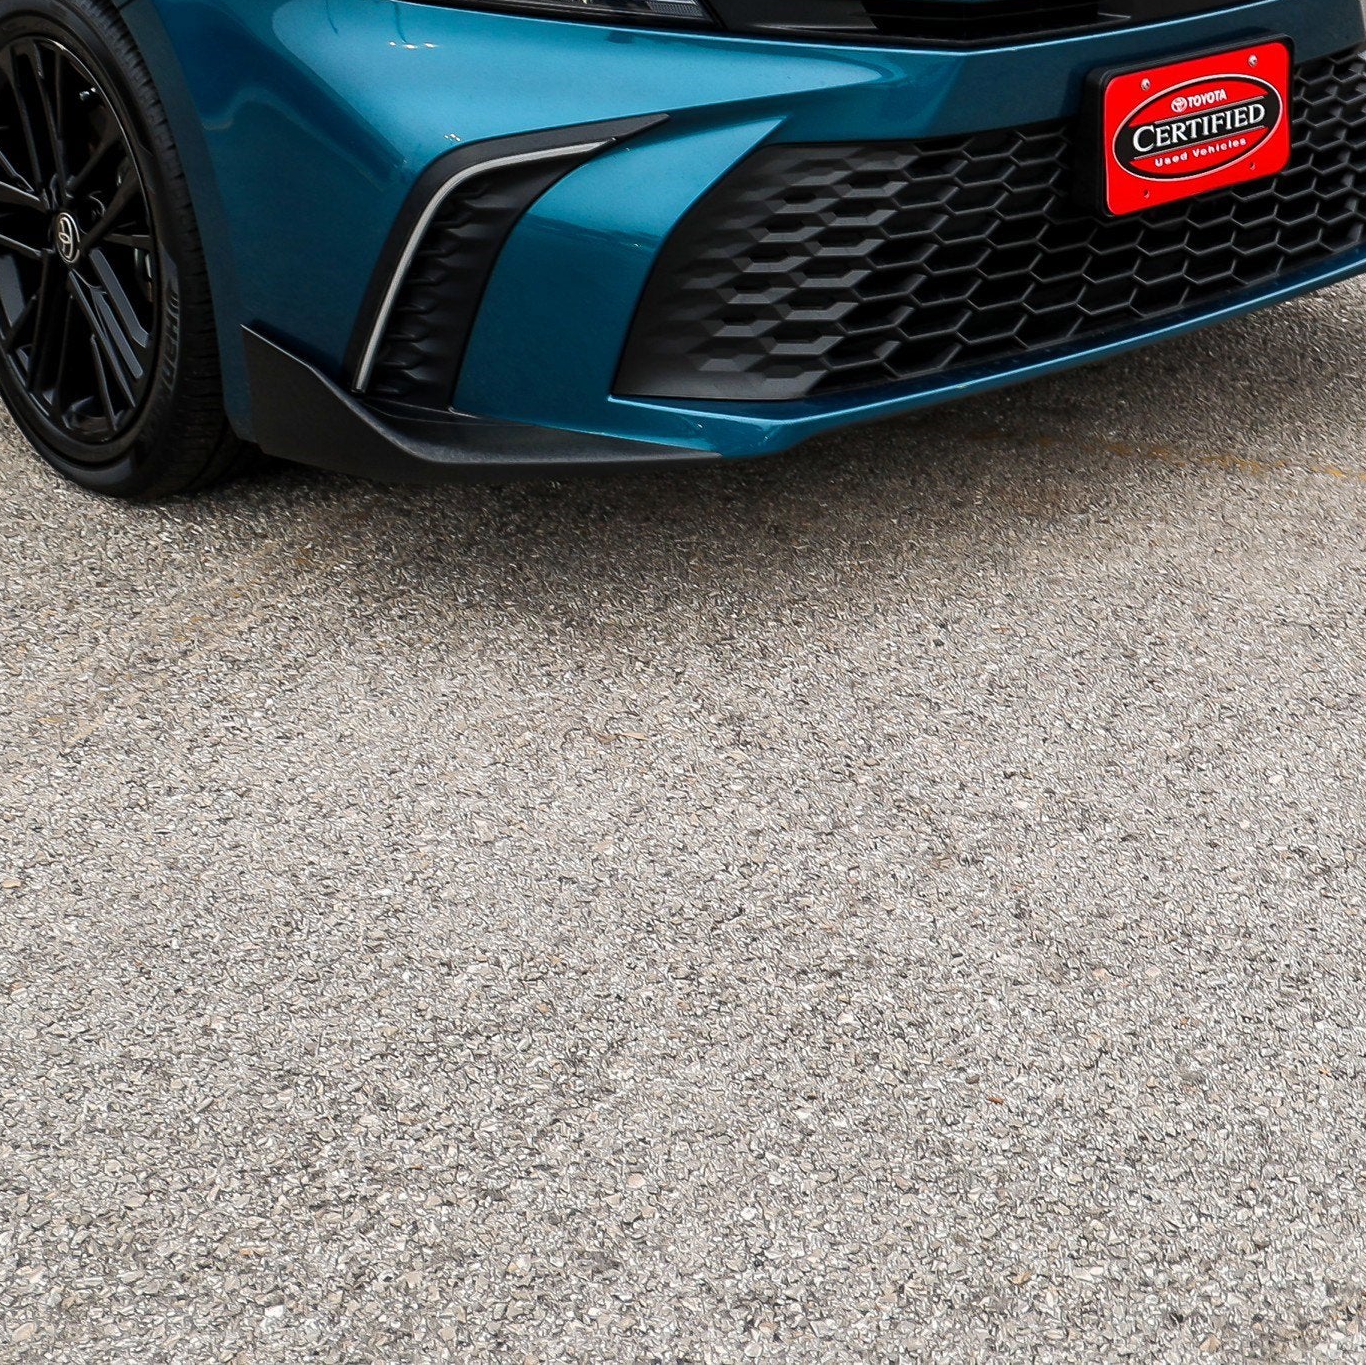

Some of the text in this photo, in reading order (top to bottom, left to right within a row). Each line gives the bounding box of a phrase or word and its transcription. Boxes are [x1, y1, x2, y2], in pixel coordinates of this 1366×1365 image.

[1187, 88, 1228, 108] TOYOTA
[1132, 103, 1266, 153] CERTIFIED
[1154, 137, 1248, 168] Used Vehicles
